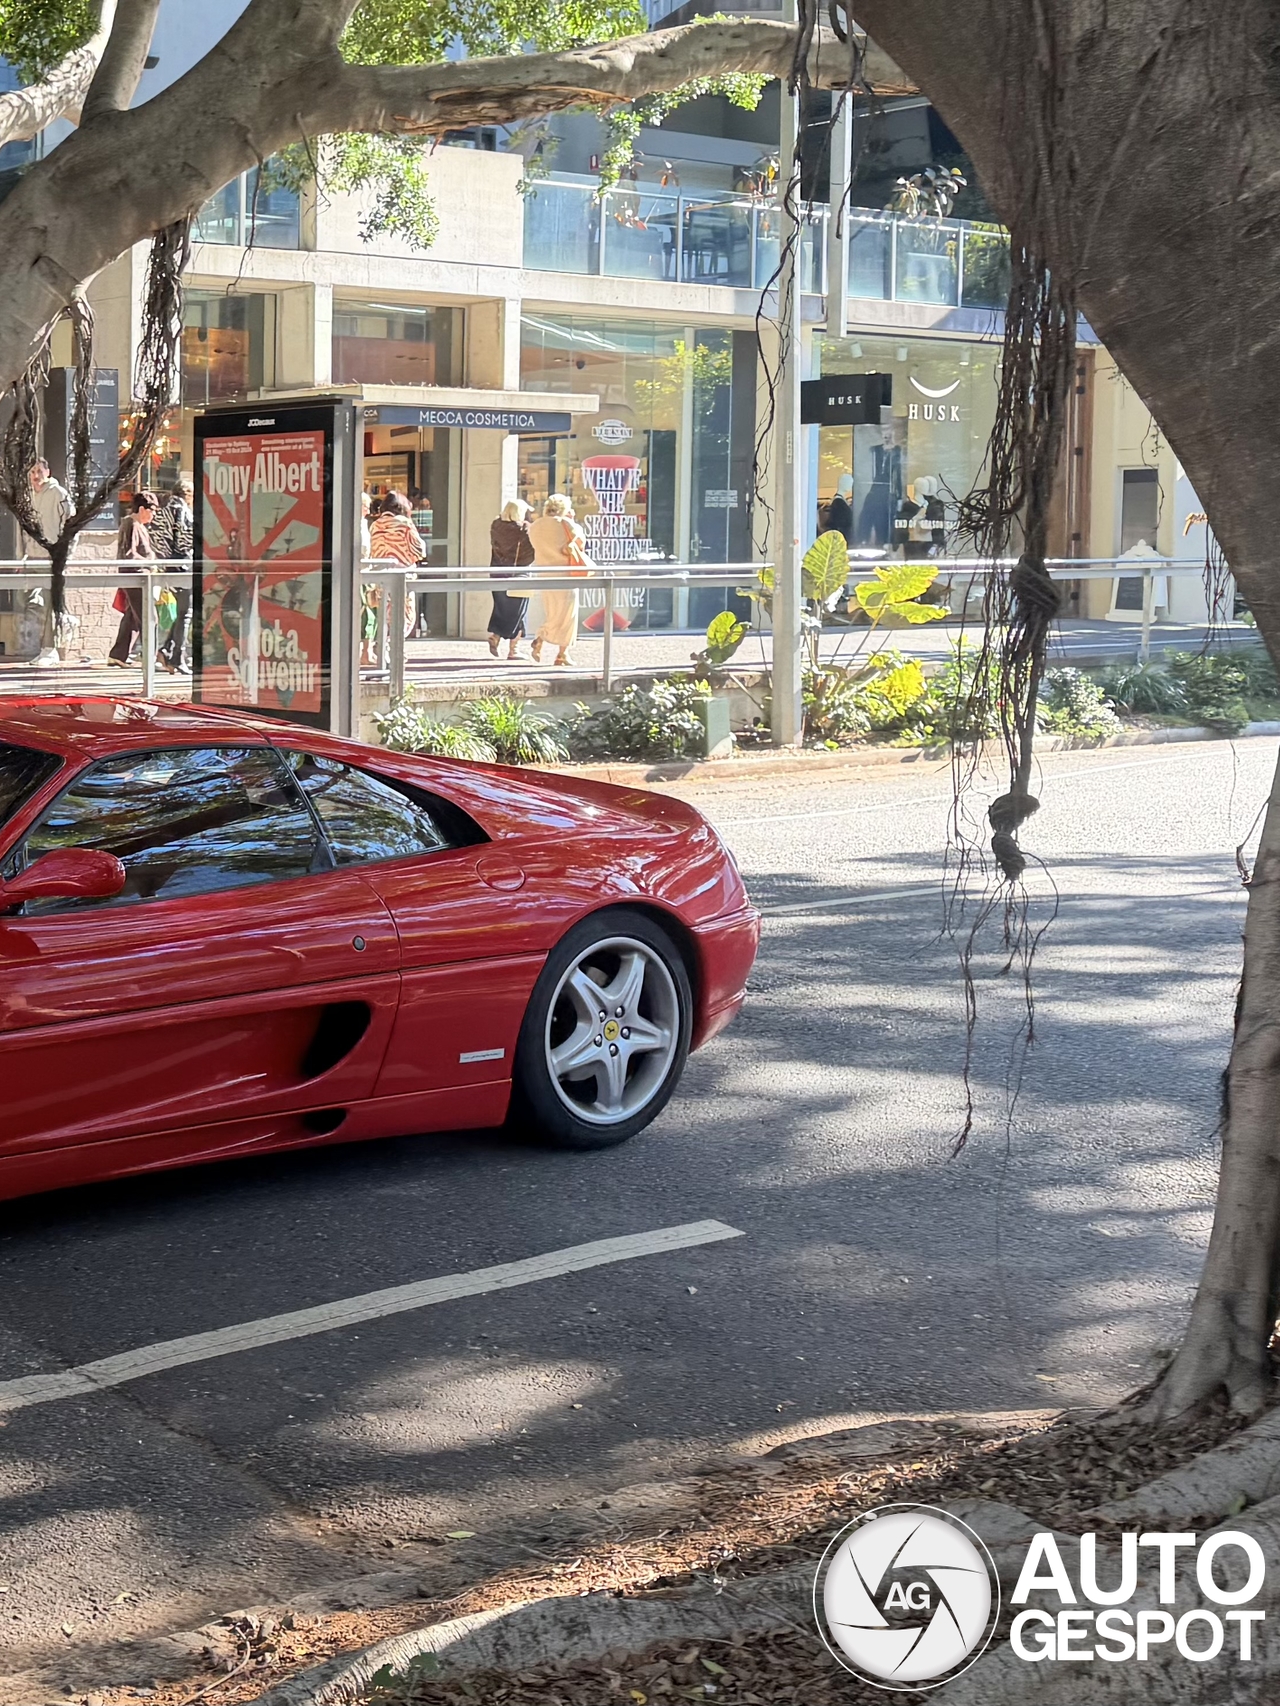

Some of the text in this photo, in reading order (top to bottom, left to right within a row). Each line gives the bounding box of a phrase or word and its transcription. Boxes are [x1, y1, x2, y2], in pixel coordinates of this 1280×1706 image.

[828, 395, 862, 406] HUSK
[420, 410, 535, 427] MECCA COSMETICA
[909, 404, 960, 422] HUSK
[206, 451, 321, 503] Tony Albert
[581, 467, 642, 491] WHAT IF
[597, 491, 626, 514] THE
[583, 514, 638, 538] SECRET
[584, 538, 652, 560] GREDIENT
